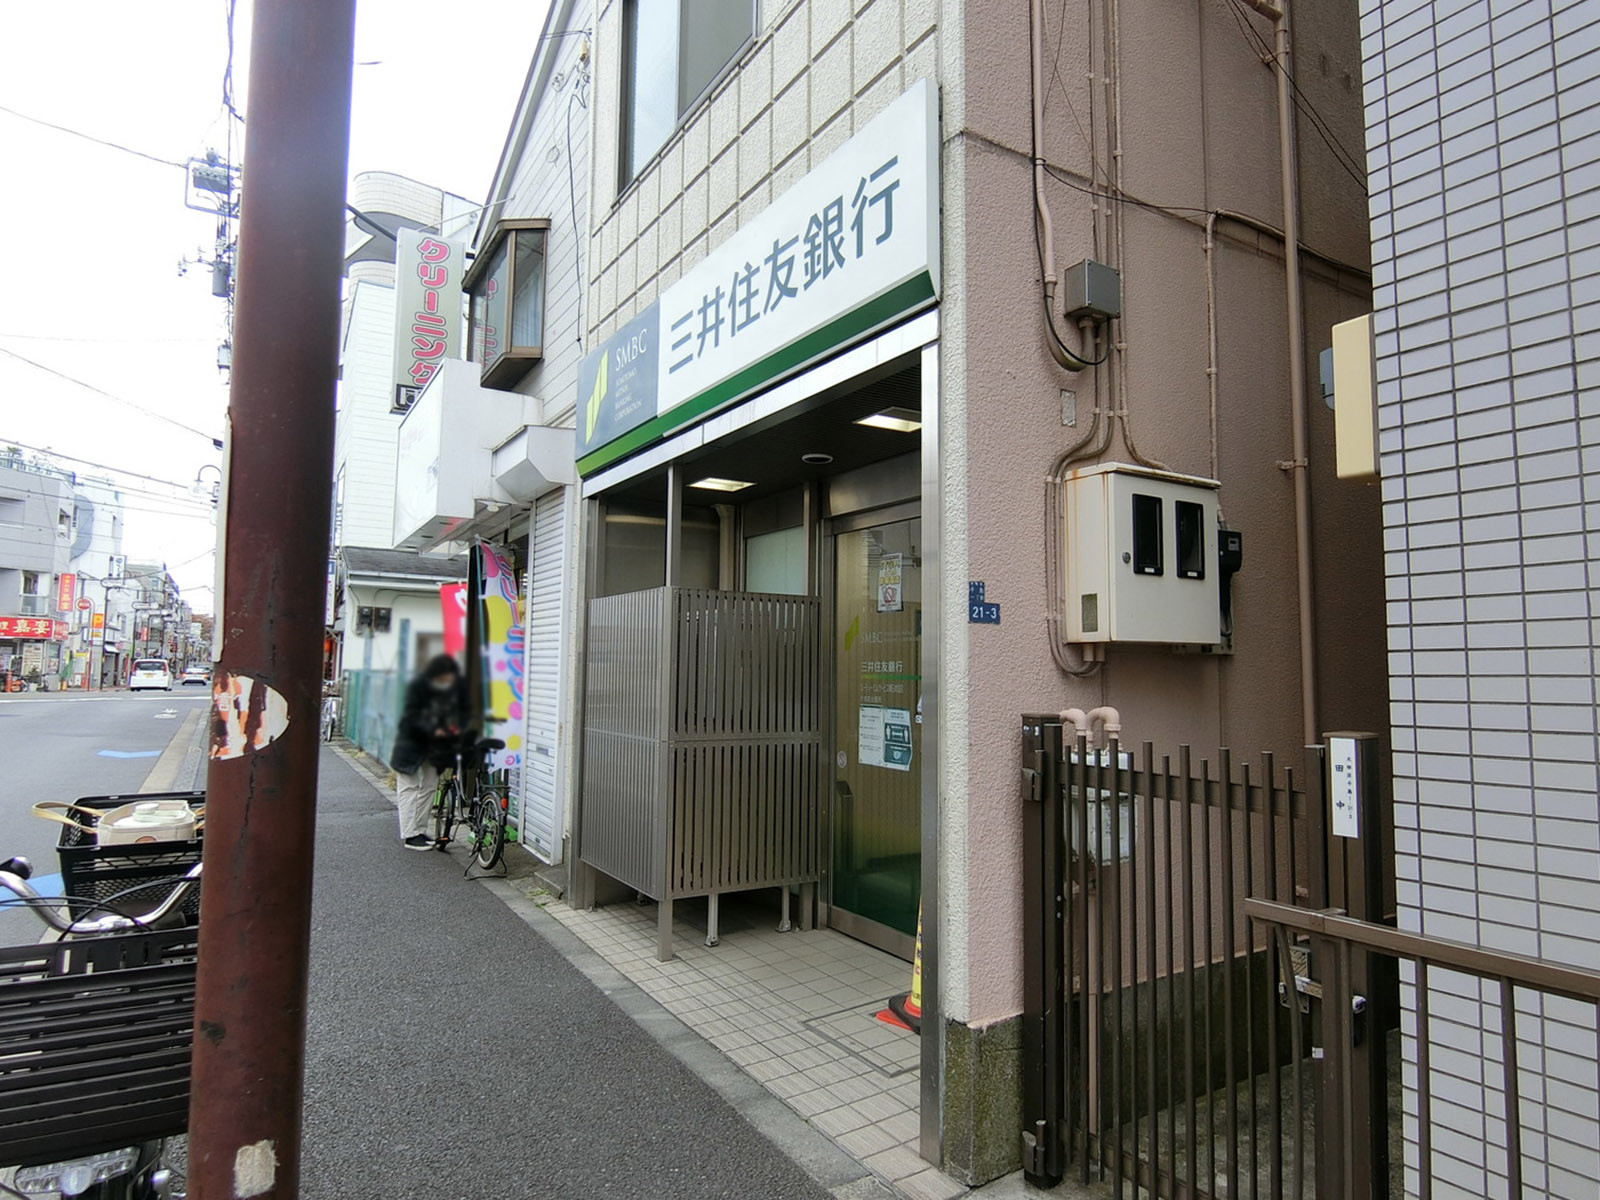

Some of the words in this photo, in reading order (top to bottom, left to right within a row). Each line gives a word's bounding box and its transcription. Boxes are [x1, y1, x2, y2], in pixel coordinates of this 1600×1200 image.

[668, 154, 901, 375] 三井住友銀行
[410, 237, 451, 386] クリーニング
[615, 328, 647, 372] SMBC
[972, 605, 997, 620] 21-3
[860, 660, 904, 673] 三井住友銀行
